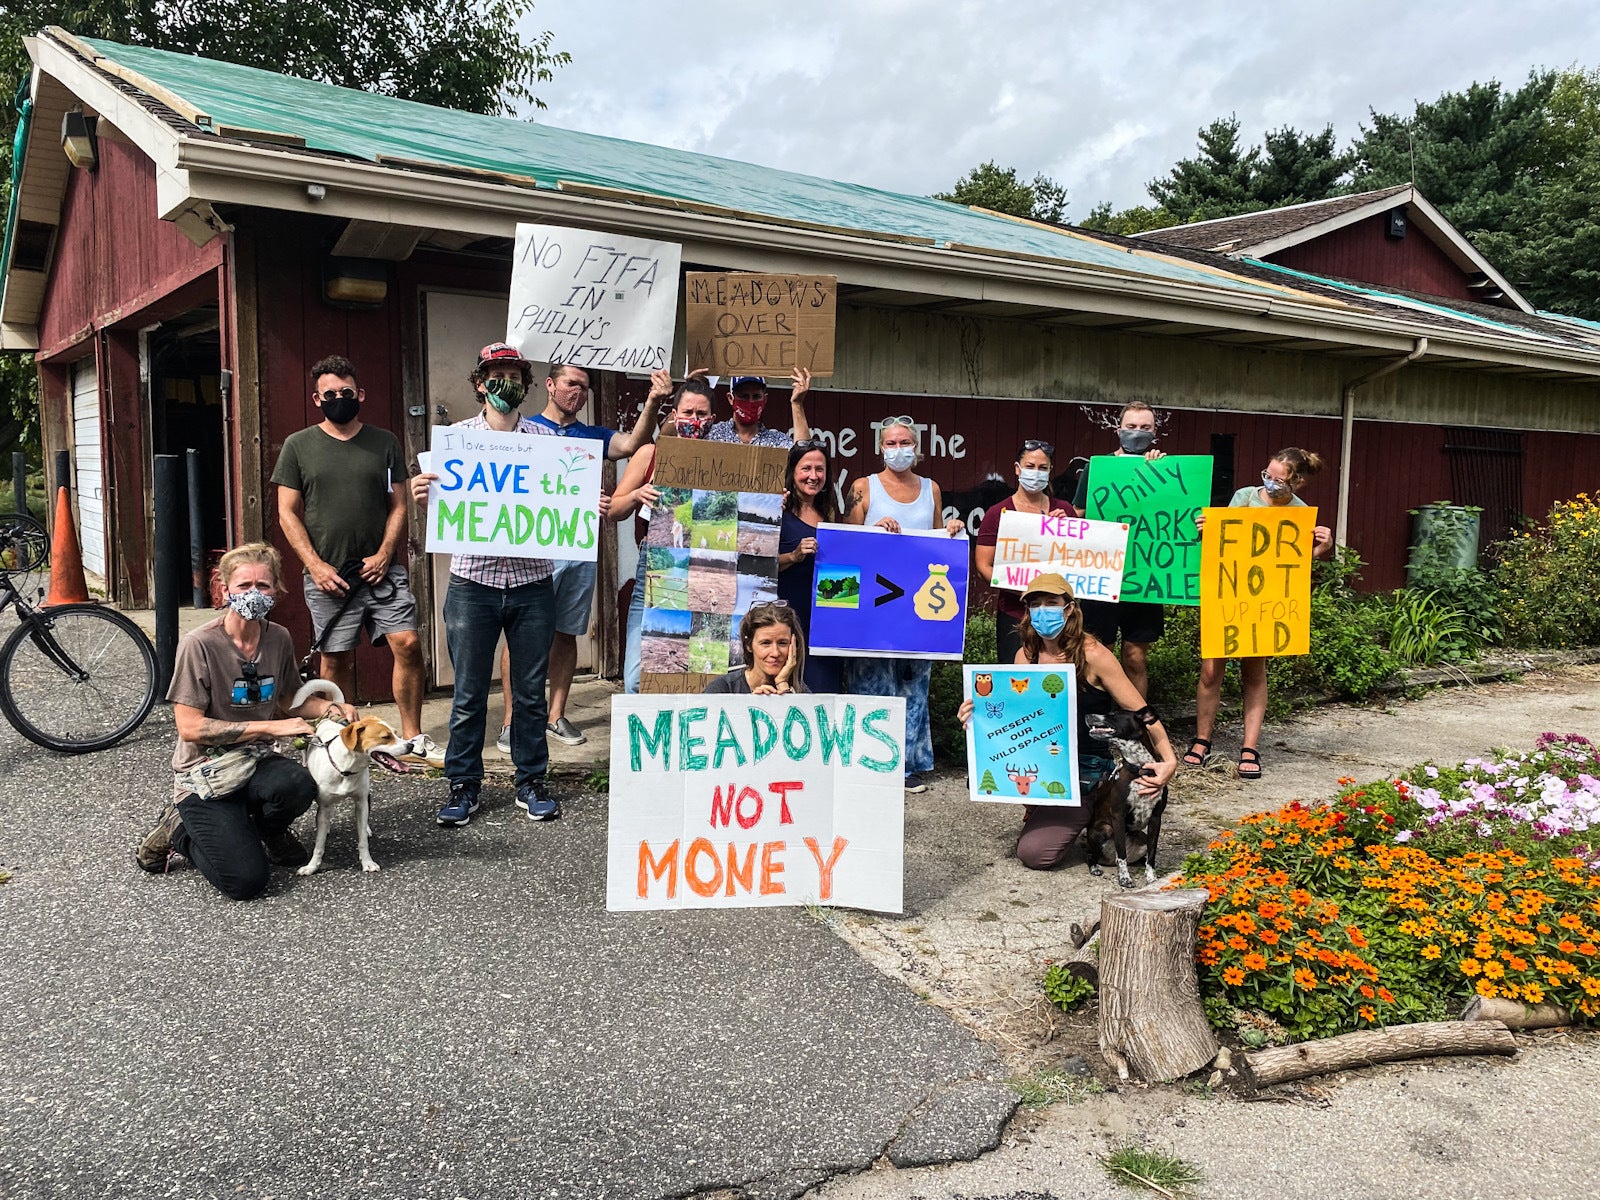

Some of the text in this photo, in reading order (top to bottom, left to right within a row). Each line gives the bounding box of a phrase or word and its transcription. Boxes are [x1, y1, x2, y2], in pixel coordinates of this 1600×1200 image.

[522, 235, 659, 298] NO FIFA
[560, 286, 607, 311] IN
[691, 278, 827, 308] MEADOWS
[717, 312, 792, 336] OVER
[550, 340, 666, 370] WETLANDS
[693, 339, 819, 371] MONEY
[444, 433, 455, 451] I
[461, 434, 485, 451] love
[517, 442, 534, 453] but
[914, 423, 967, 460] The
[440, 458, 581, 496] SAVE the
[1092, 459, 1188, 521] Philly
[437, 499, 597, 550] MEADOWS
[1040, 515, 1090, 540] KEEP
[1219, 519, 1303, 558] FDR
[998, 537, 1124, 572] THE MEADOWS
[1132, 541, 1198, 569] NOT
[1065, 573, 1111, 596] FREE
[1120, 571, 1201, 600] SALE
[1218, 560, 1301, 600] NOT
[1222, 599, 1301, 623] UP FOR
[1223, 620, 1291, 656] BID
[627, 702, 901, 773] MEADOWS
[986, 708, 1045, 740] PRESERVE
[1009, 726, 1033, 741] OUR
[989, 745, 1018, 762] WILD
[709, 780, 805, 830] NOT
[636, 836, 849, 901] MONEY
